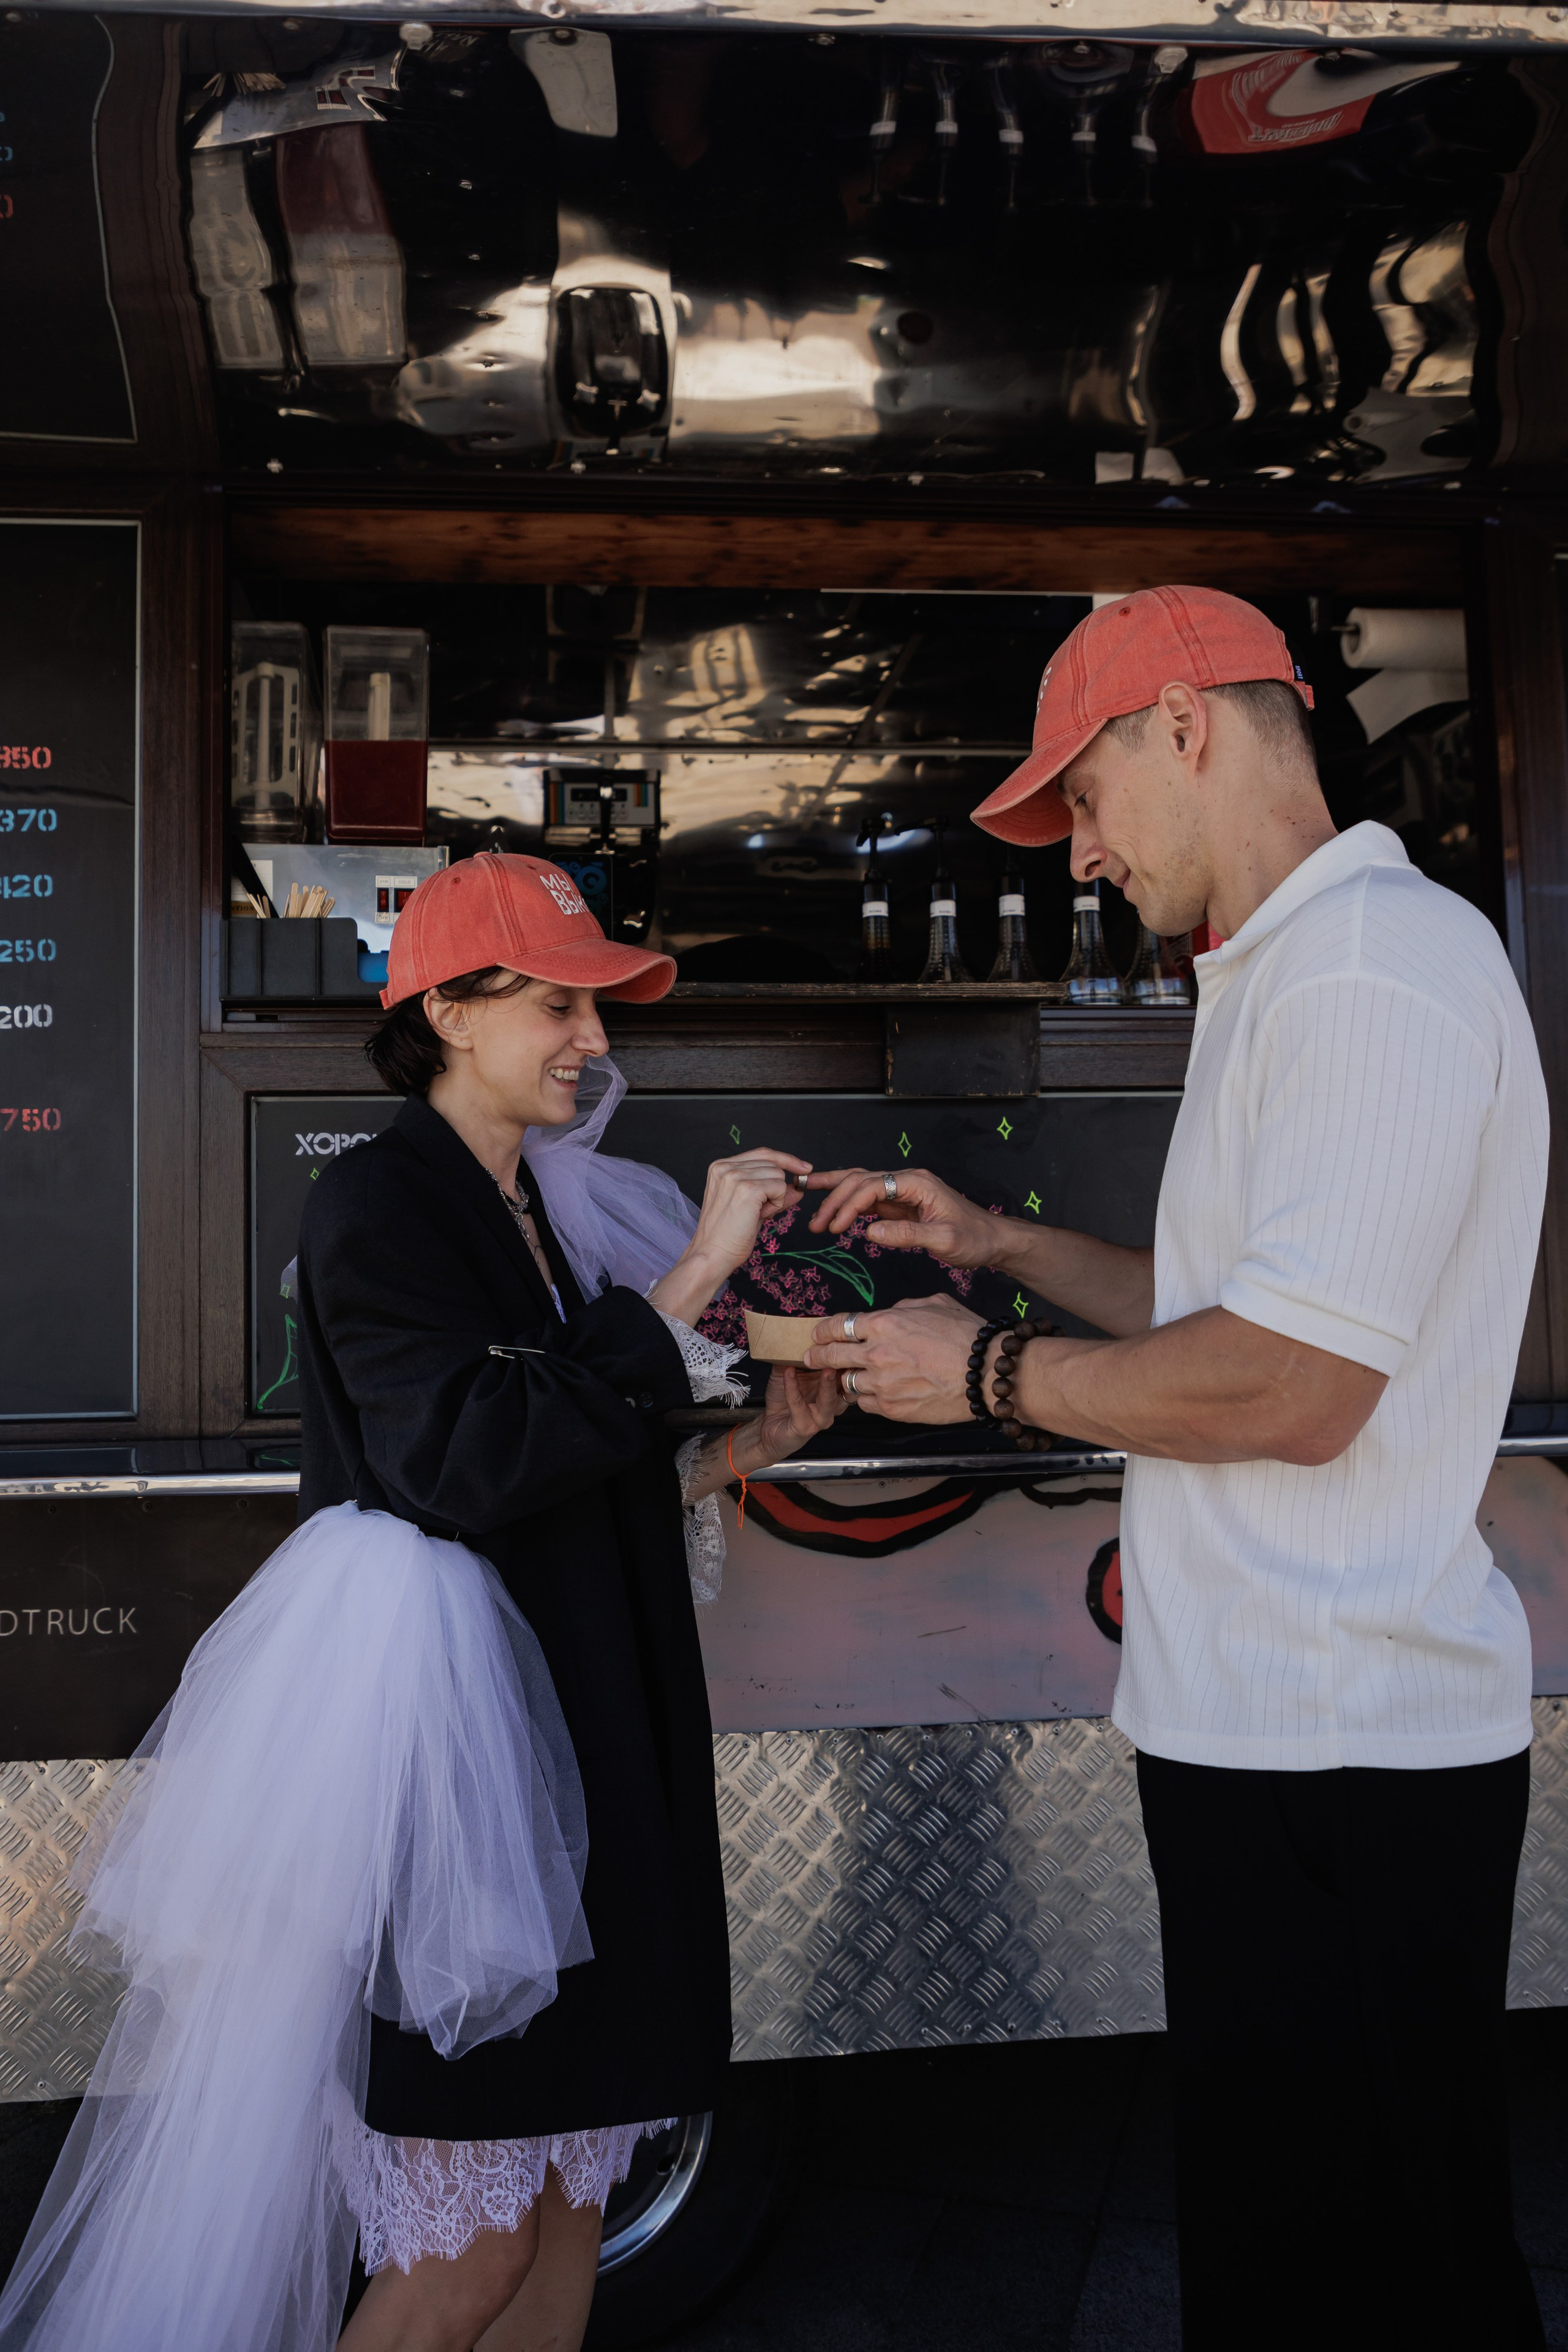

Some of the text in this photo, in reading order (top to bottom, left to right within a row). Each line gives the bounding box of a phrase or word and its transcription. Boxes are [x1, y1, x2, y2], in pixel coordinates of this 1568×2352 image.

[0, 809, 58, 832] 370
[0, 938, 56, 963] 250
[0, 1004, 53, 1029] 200
[0, 1107, 61, 1132] 750
[0, 1607, 137, 1637] DTRUCK
